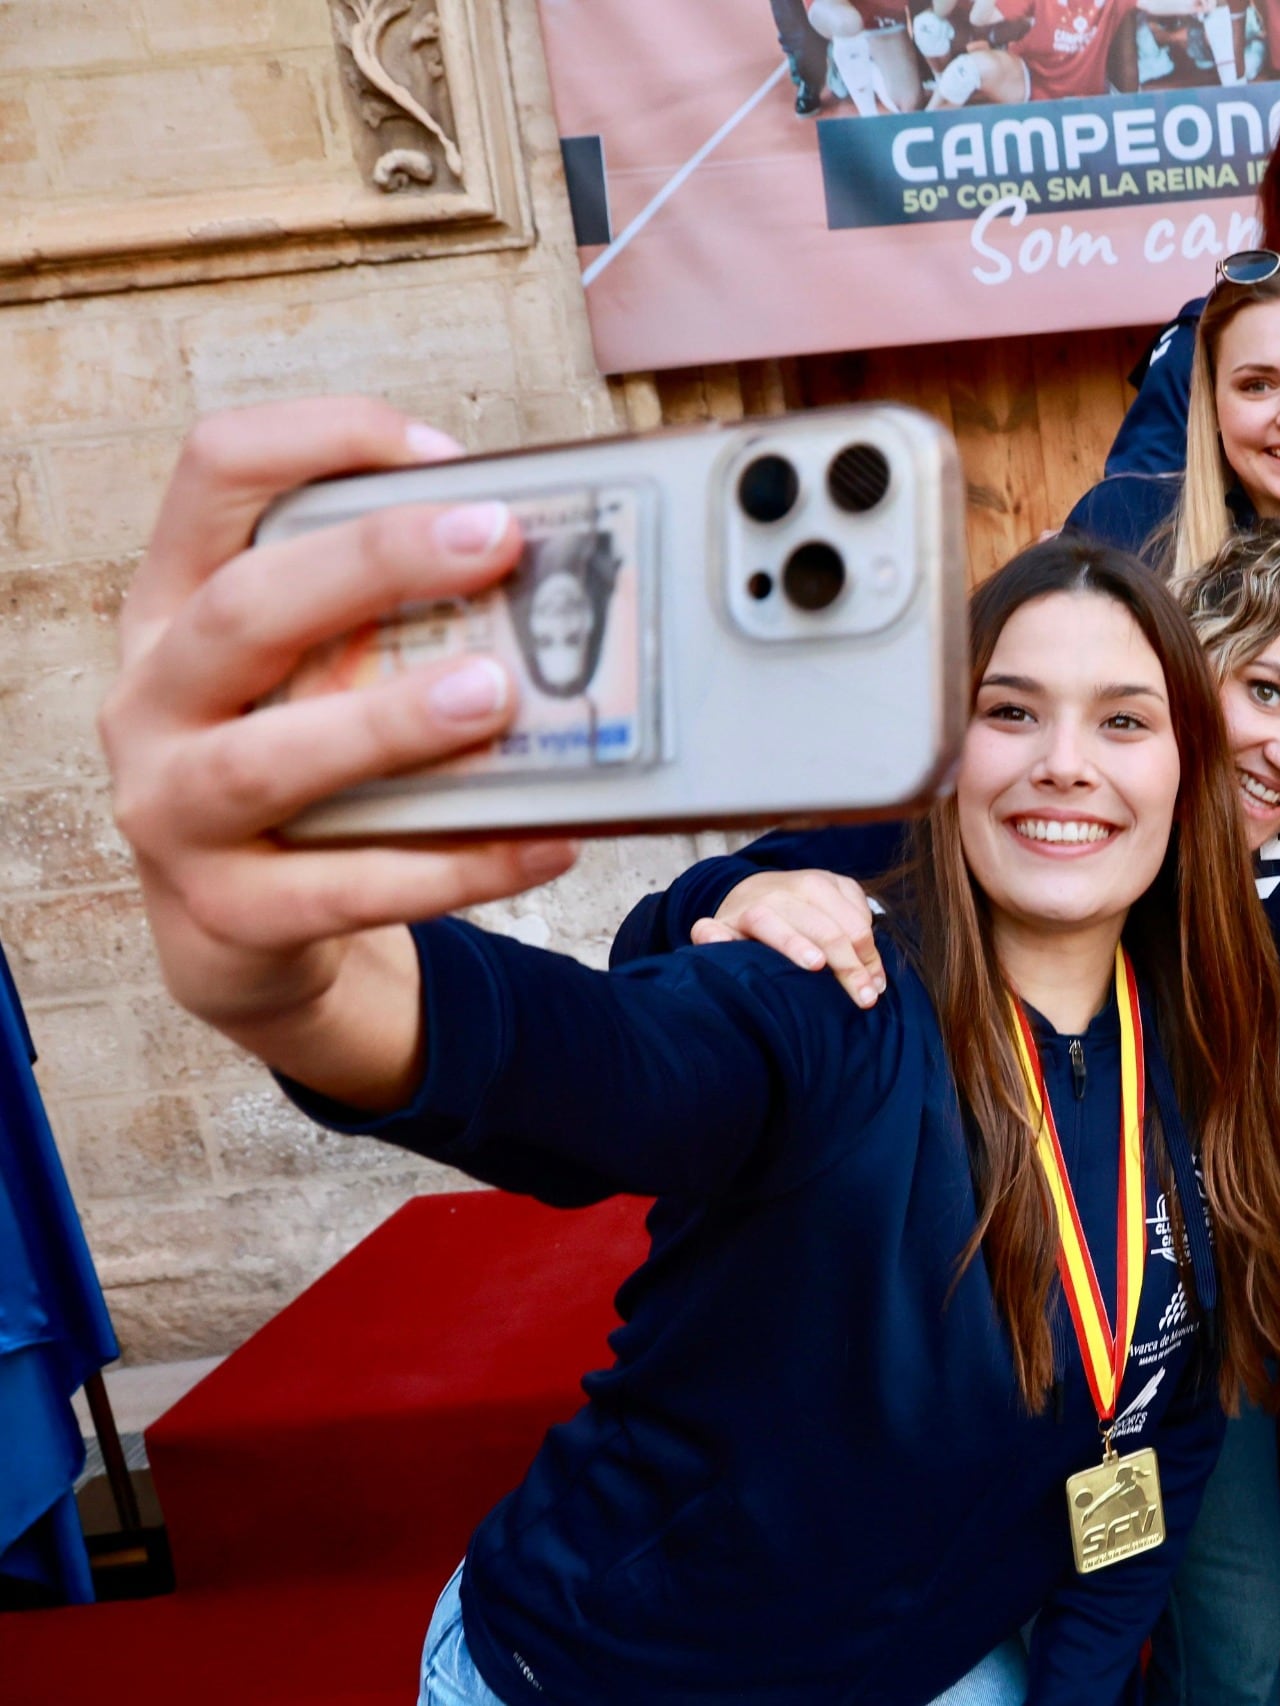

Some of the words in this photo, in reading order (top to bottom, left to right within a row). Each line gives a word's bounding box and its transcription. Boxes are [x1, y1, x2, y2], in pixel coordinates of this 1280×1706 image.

[903, 186, 949, 214] 50ª
[956, 179, 1041, 210] COPA
[1047, 174, 1092, 202] SM
[1100, 171, 1139, 197] LA
[1146, 160, 1239, 194] REINA
[970, 195, 1118, 286] Som
[1159, 1334, 1170, 1349] de
[1080, 1503, 1158, 1556] SFV
